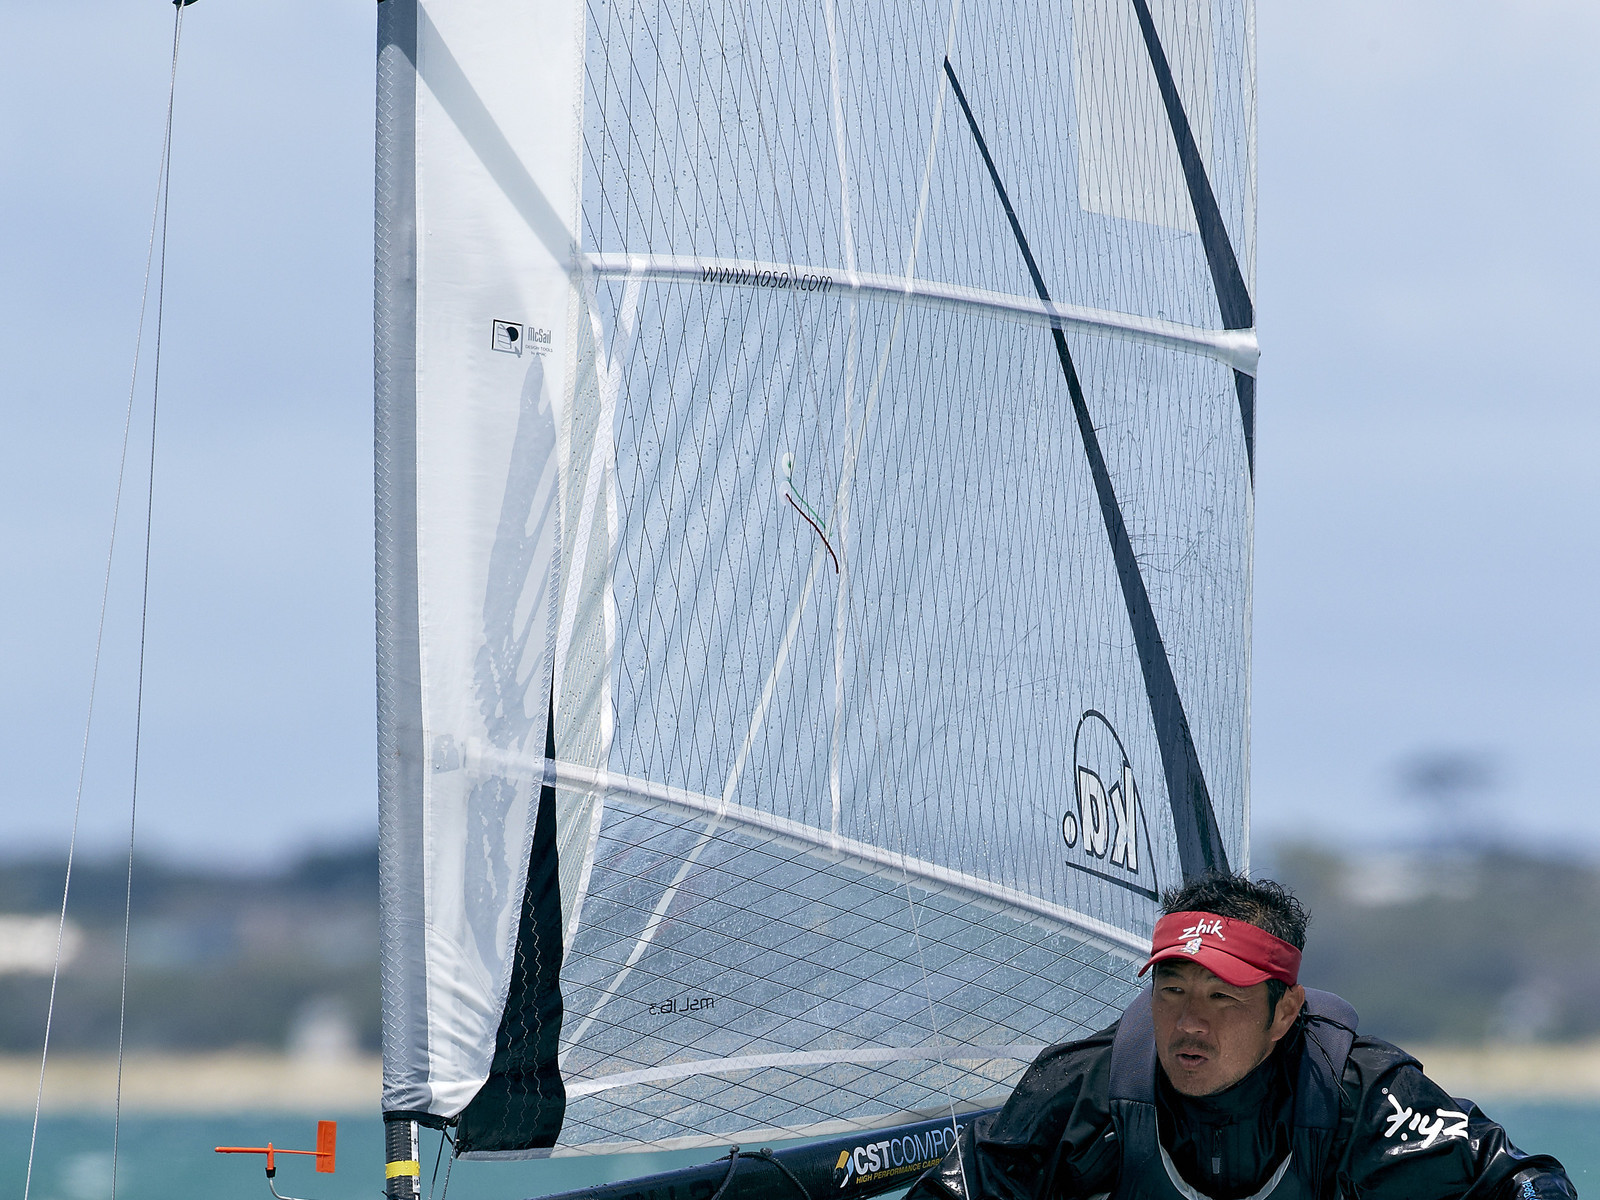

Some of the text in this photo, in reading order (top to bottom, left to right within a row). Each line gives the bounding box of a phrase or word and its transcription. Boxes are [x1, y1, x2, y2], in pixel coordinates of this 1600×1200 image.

[528, 326, 552, 344] McSail
[1178, 918, 1224, 940] zhik
[1384, 1093, 1469, 1149] zhik
[856, 1157, 943, 1184] HIGH PERFORMANCE CARB
